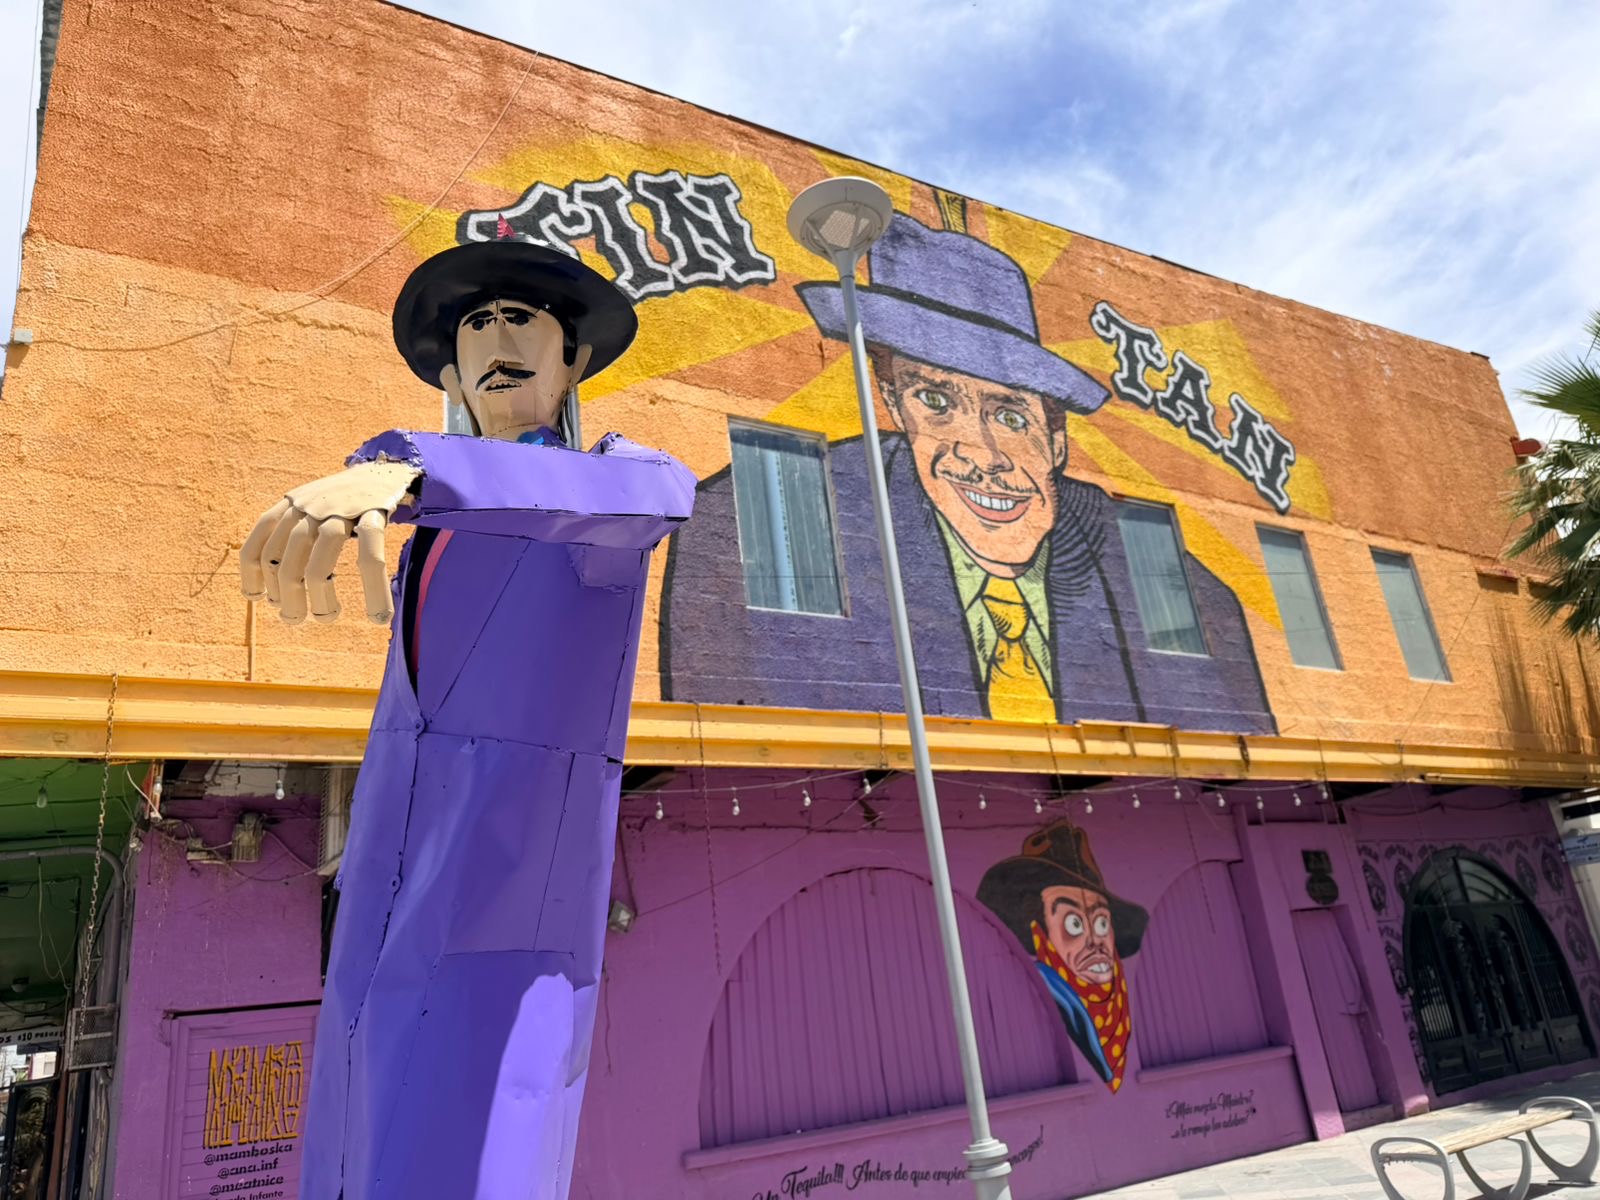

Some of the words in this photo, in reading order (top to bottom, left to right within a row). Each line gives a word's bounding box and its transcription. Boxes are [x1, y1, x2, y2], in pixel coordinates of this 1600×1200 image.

[1089, 300, 1296, 516] TAN
[203, 1143, 293, 1166] @mamboska
[217, 1157, 279, 1179] @ana.inf
[781, 1163, 844, 1198] Tequila!!!
[846, 1160, 892, 1190] Antes
[894, 1162, 909, 1181] de
[910, 1169, 931, 1187] que
